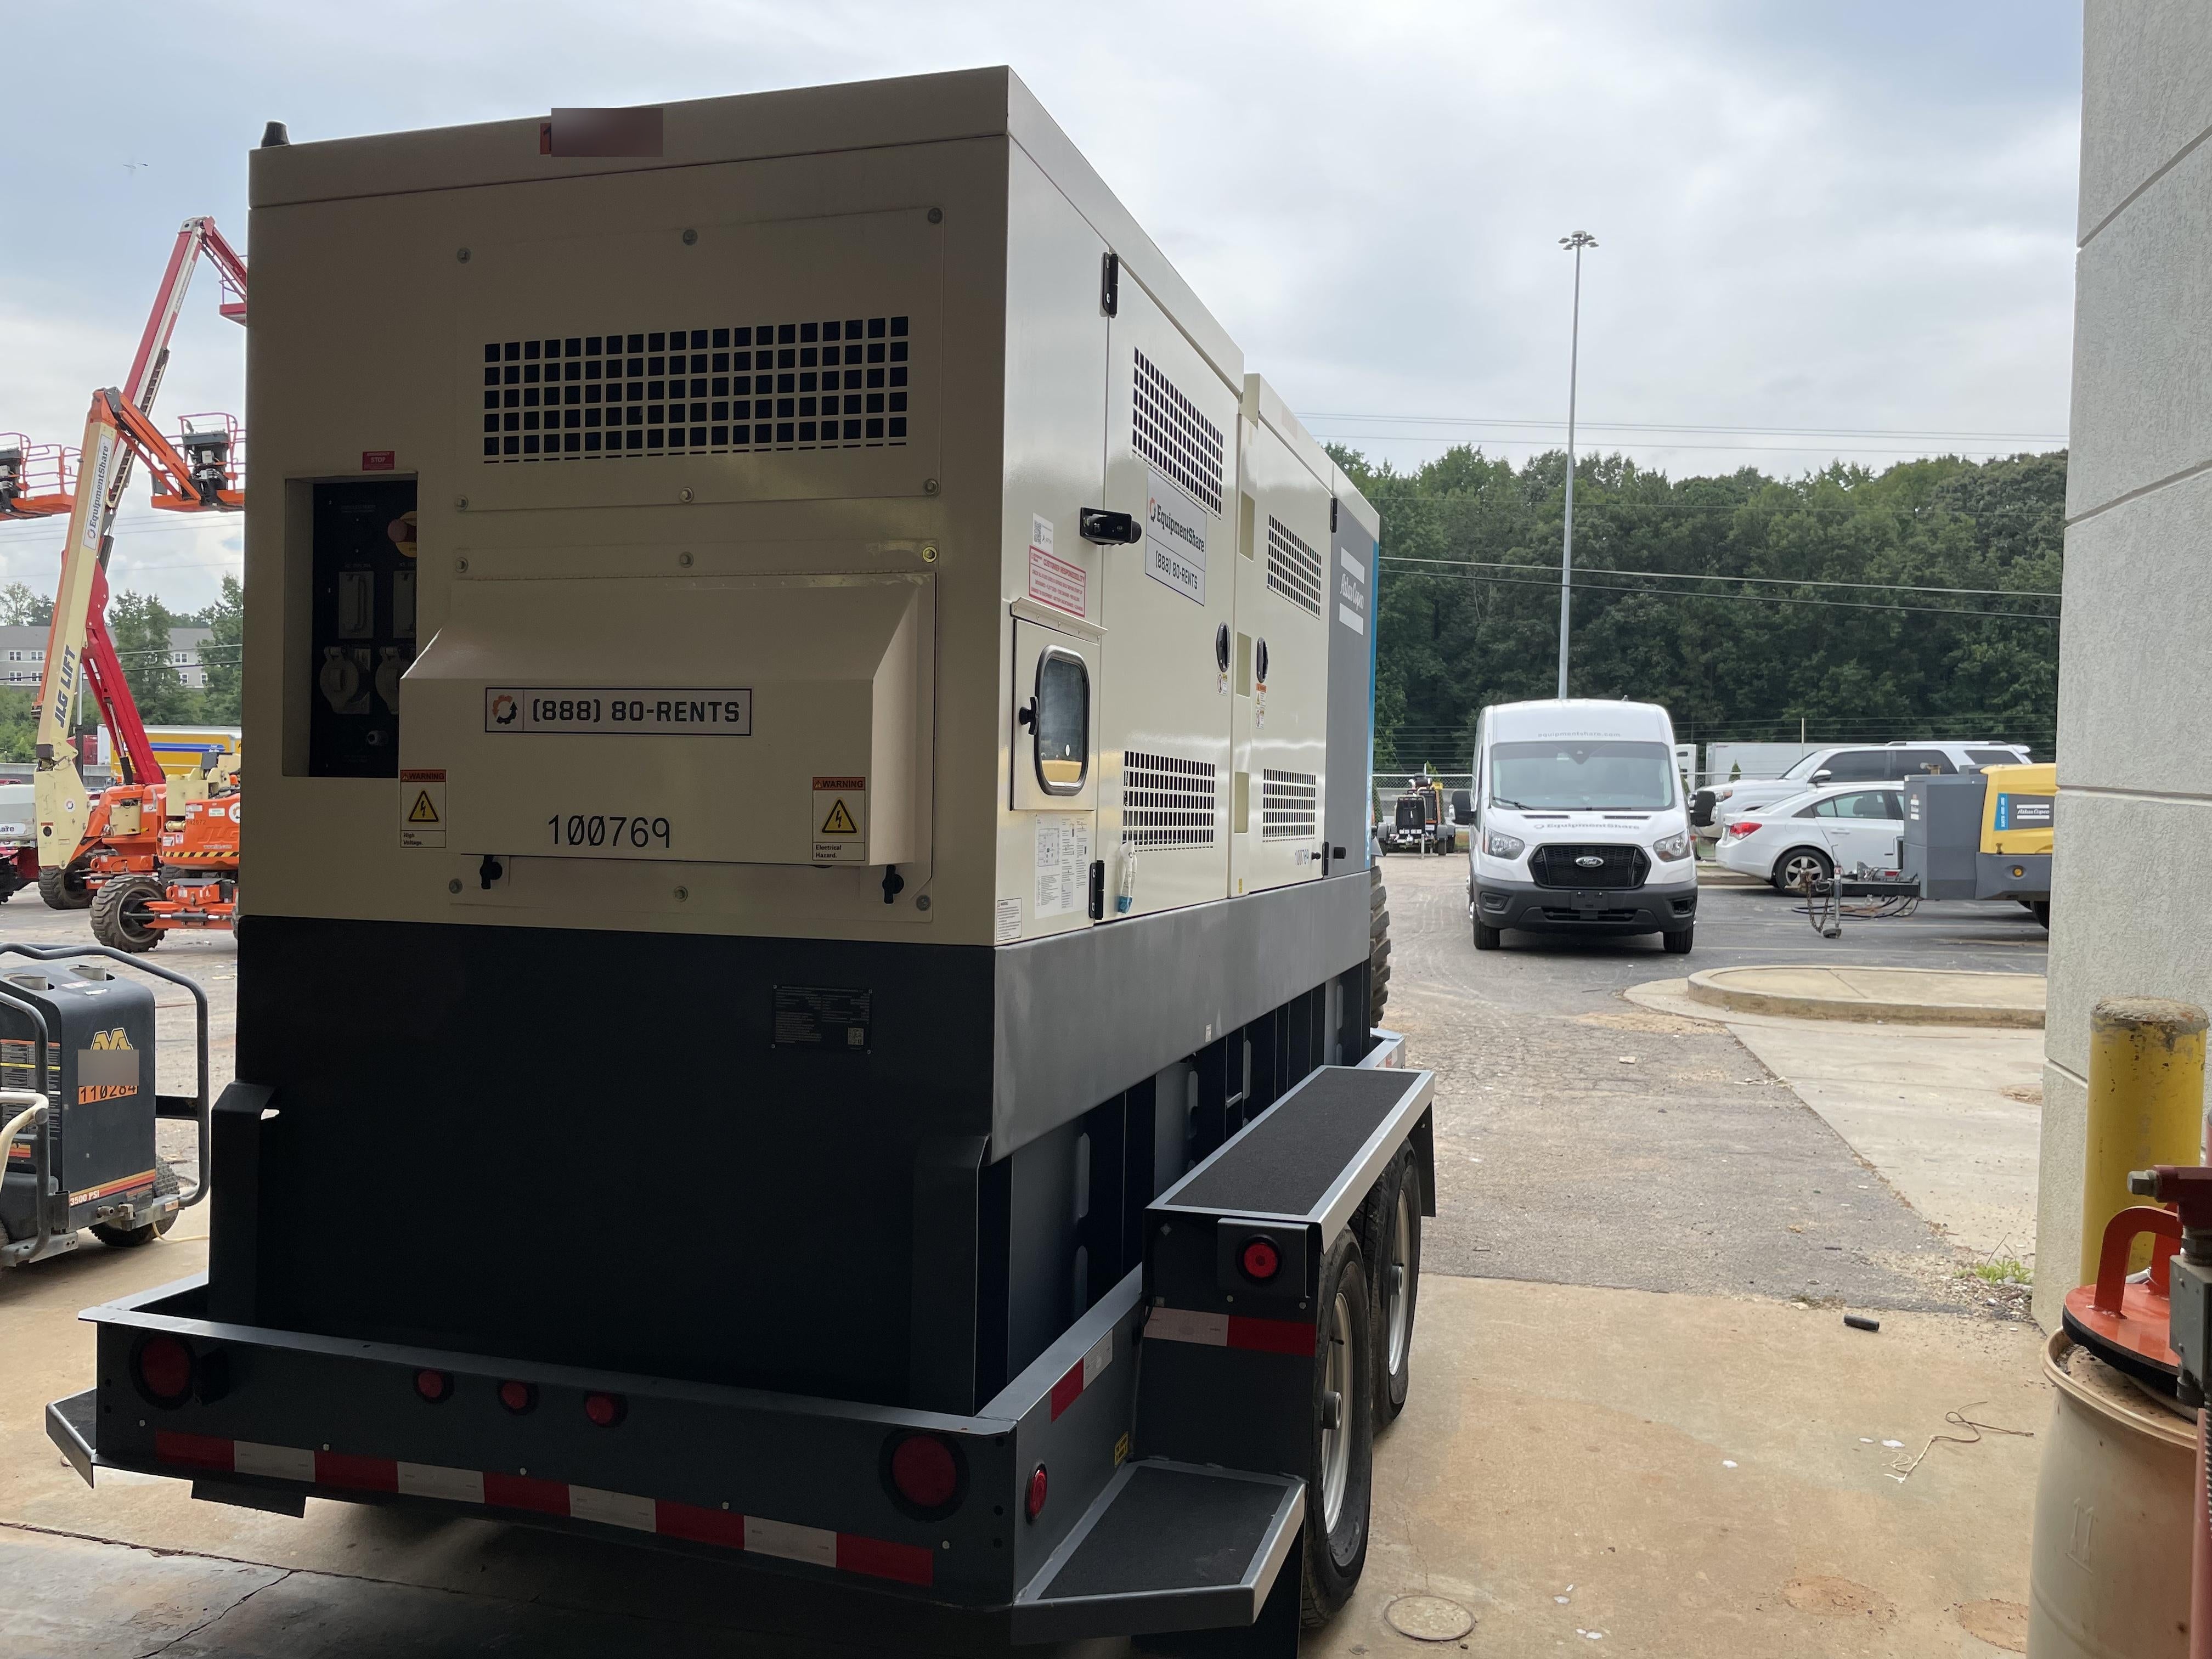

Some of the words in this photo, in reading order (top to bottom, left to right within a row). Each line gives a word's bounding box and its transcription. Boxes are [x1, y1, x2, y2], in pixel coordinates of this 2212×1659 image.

[89, 446, 109, 528] EquipmentShare
[1157, 504, 1204, 553] EquipmentShare
[1155, 550, 1171, 575] (888)
[1172, 562, 1198, 590] 80-RENTS
[1340, 573, 1353, 602] Atlas
[60, 644, 75, 690] LIFT
[55, 689, 69, 729] JLG
[532, 698, 601, 723] (888)
[612, 701, 740, 723] 80-RENTS
[549, 815, 670, 848] 100769
[70, 1194, 87, 1206] 3500
[89, 1190, 100, 1200] PSI
